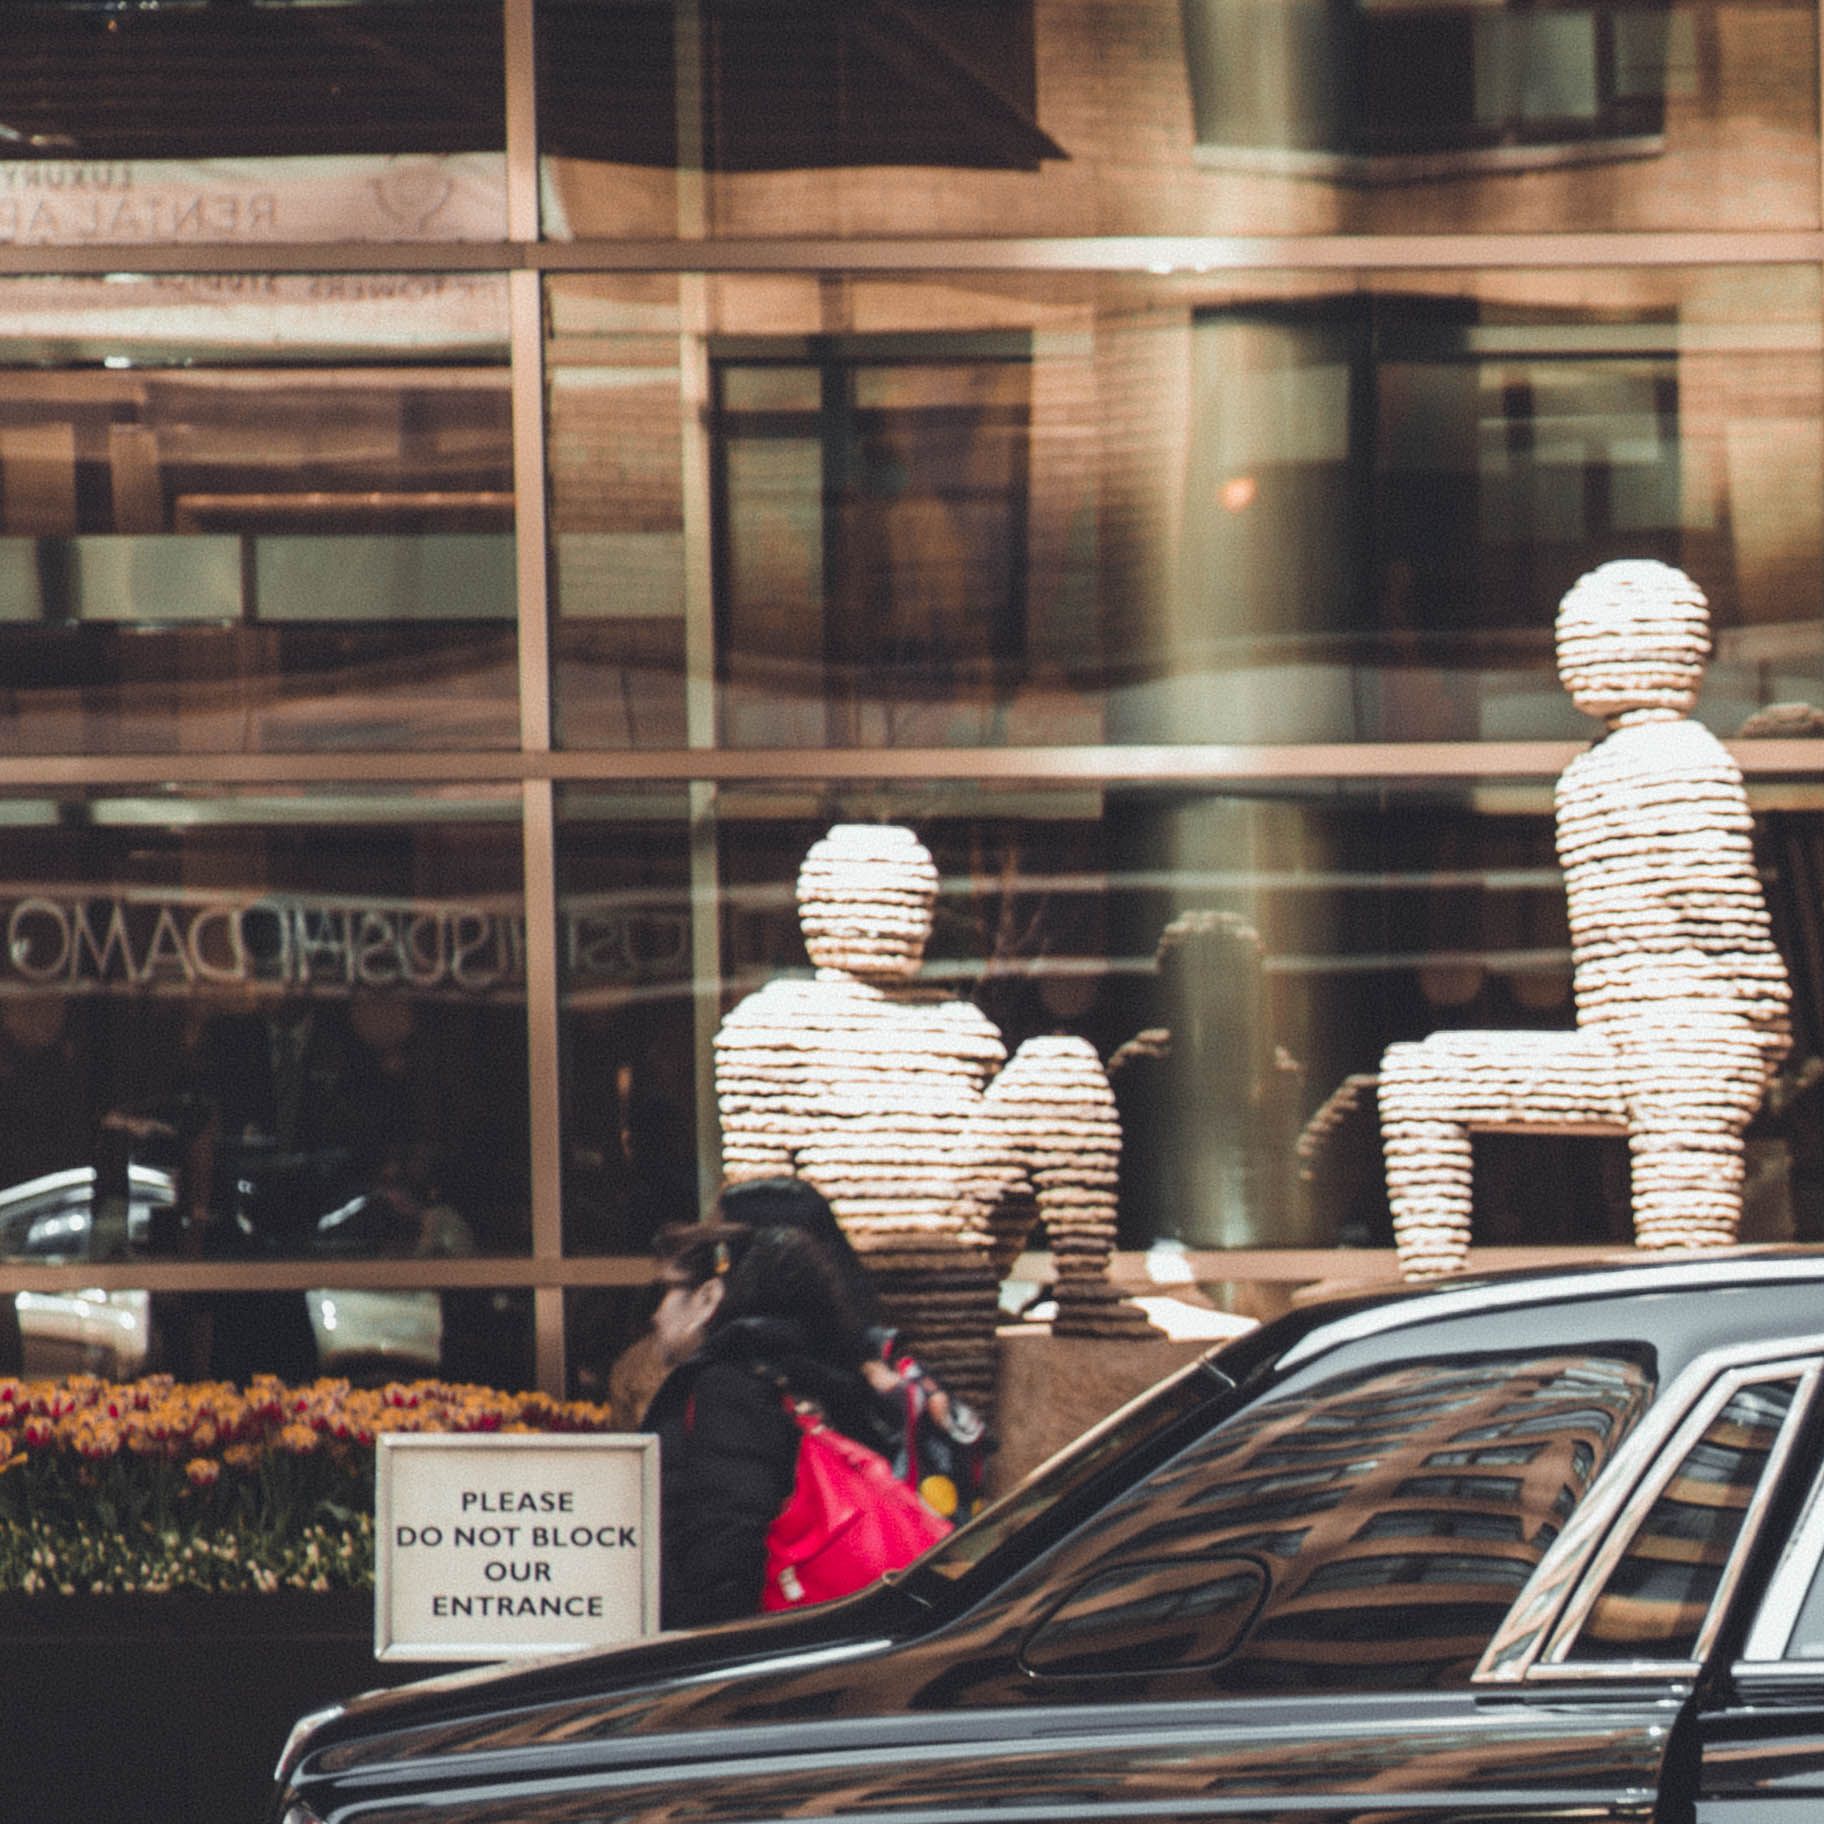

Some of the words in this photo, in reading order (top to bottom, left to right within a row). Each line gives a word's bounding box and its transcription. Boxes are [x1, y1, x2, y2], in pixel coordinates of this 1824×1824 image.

[461, 1491, 574, 1513] PLEASE
[396, 1526, 443, 1548] DO
[453, 1526, 521, 1548] NOT
[532, 1526, 638, 1548] BLOCK
[484, 1561, 552, 1583] OUR
[432, 1595, 604, 1617] ENTRANCE
